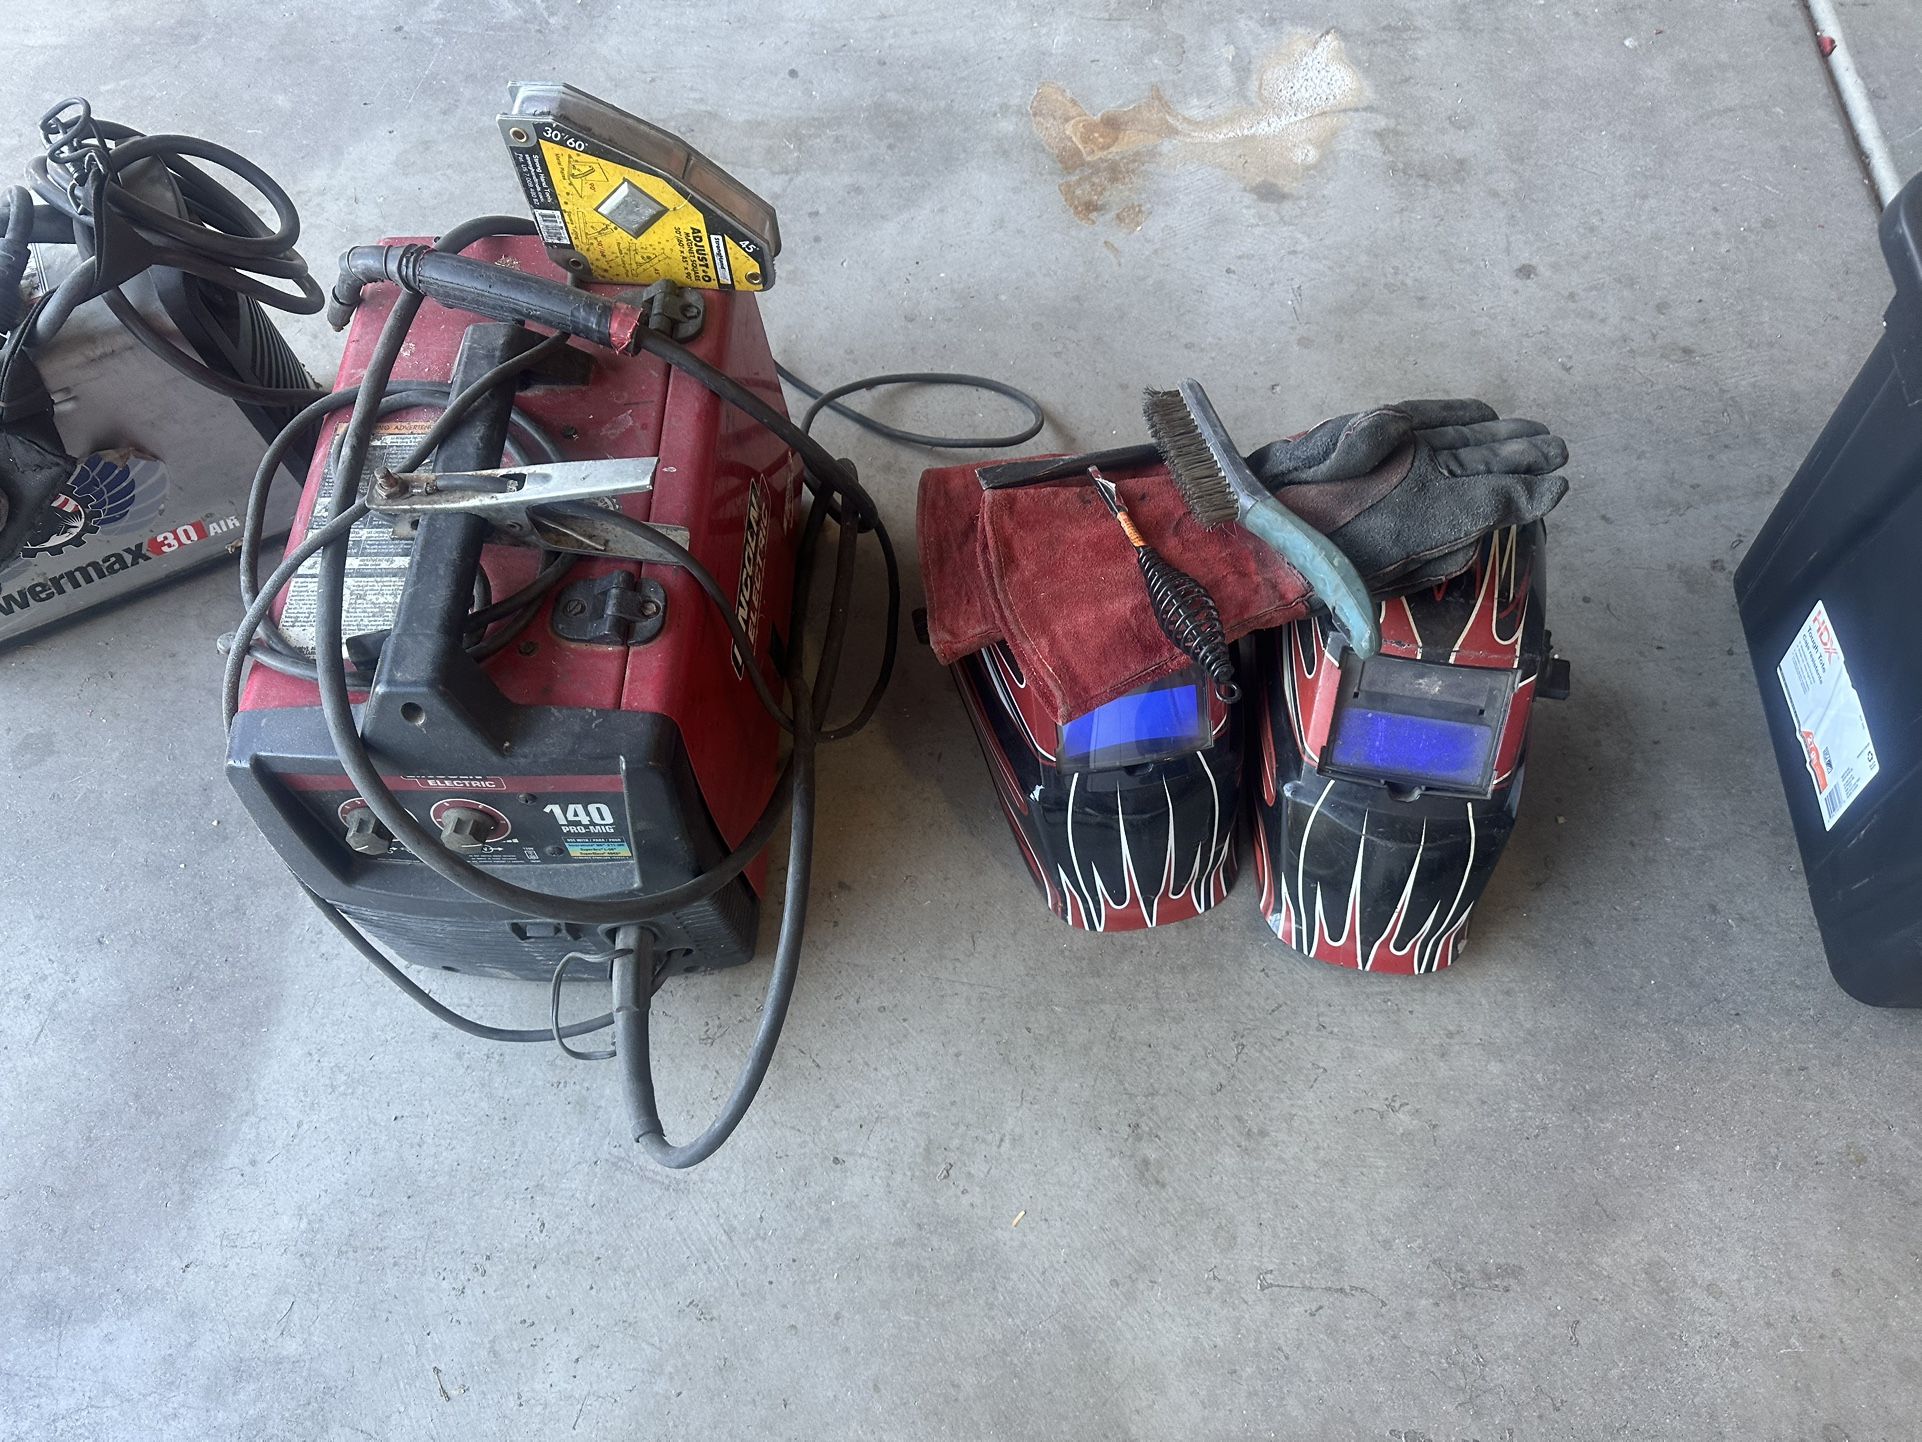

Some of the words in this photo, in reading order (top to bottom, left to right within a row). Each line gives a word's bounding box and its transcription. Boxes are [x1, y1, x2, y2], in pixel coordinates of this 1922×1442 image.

[684, 232, 695, 258] MAGNET
[208, 515, 241, 537] AIR
[1812, 610, 1835, 664] HDX
[1807, 626, 1819, 654] Tough
[1818, 654, 1826, 673] Tote
[427, 780, 496, 788] ELECTRIC
[543, 803, 614, 825] 140
